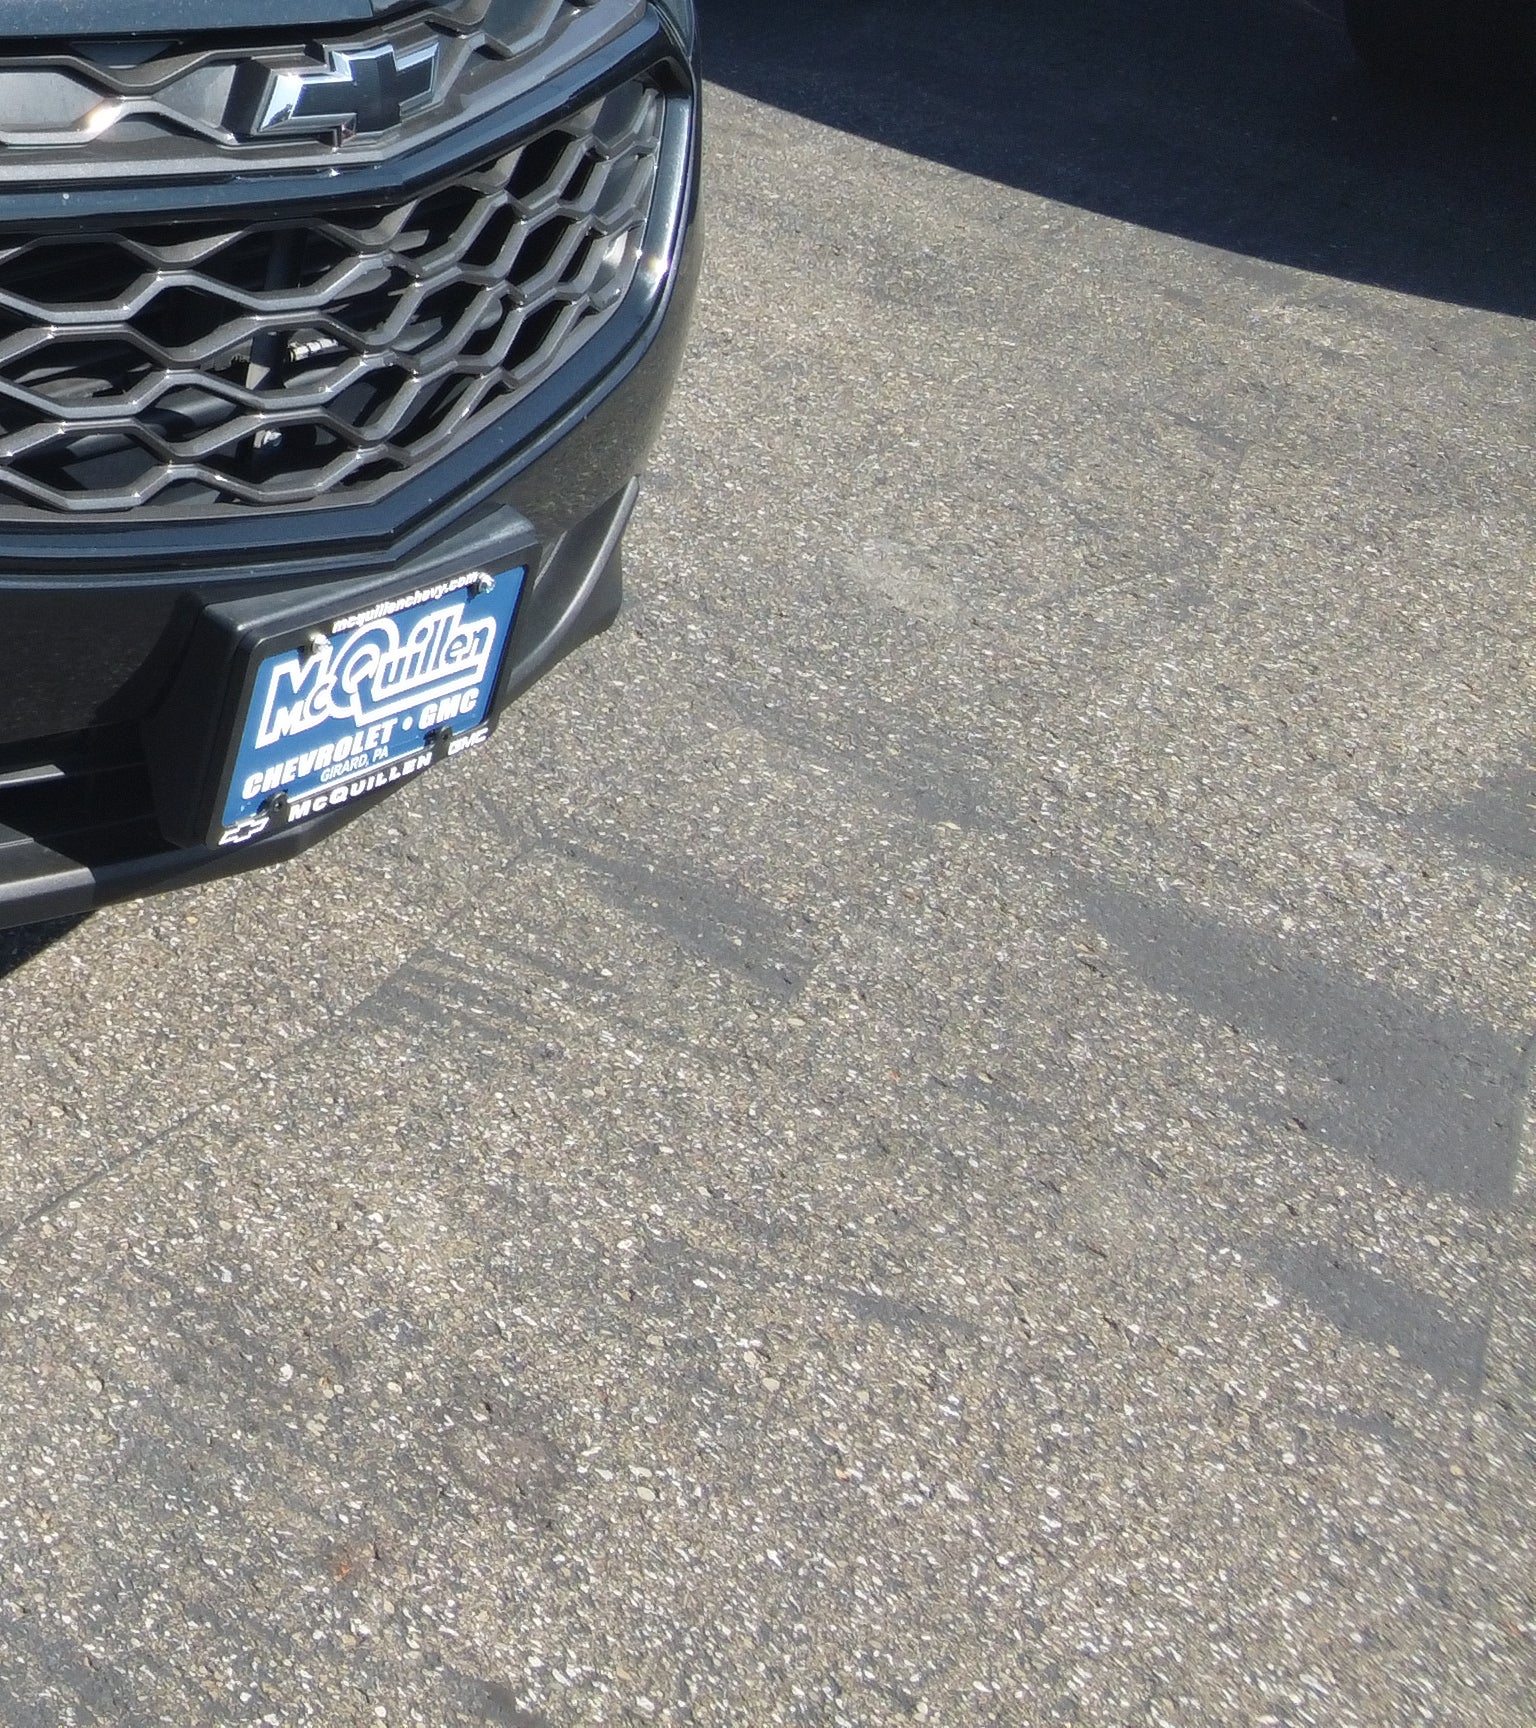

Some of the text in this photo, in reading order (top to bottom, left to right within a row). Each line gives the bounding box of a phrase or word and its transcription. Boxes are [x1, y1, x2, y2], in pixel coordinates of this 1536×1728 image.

[241, 687, 480, 801] CHEVROLET GMC
[287, 727, 490, 822] McQUILLEN GMC
[319, 745, 390, 784] GIRARD, PA
